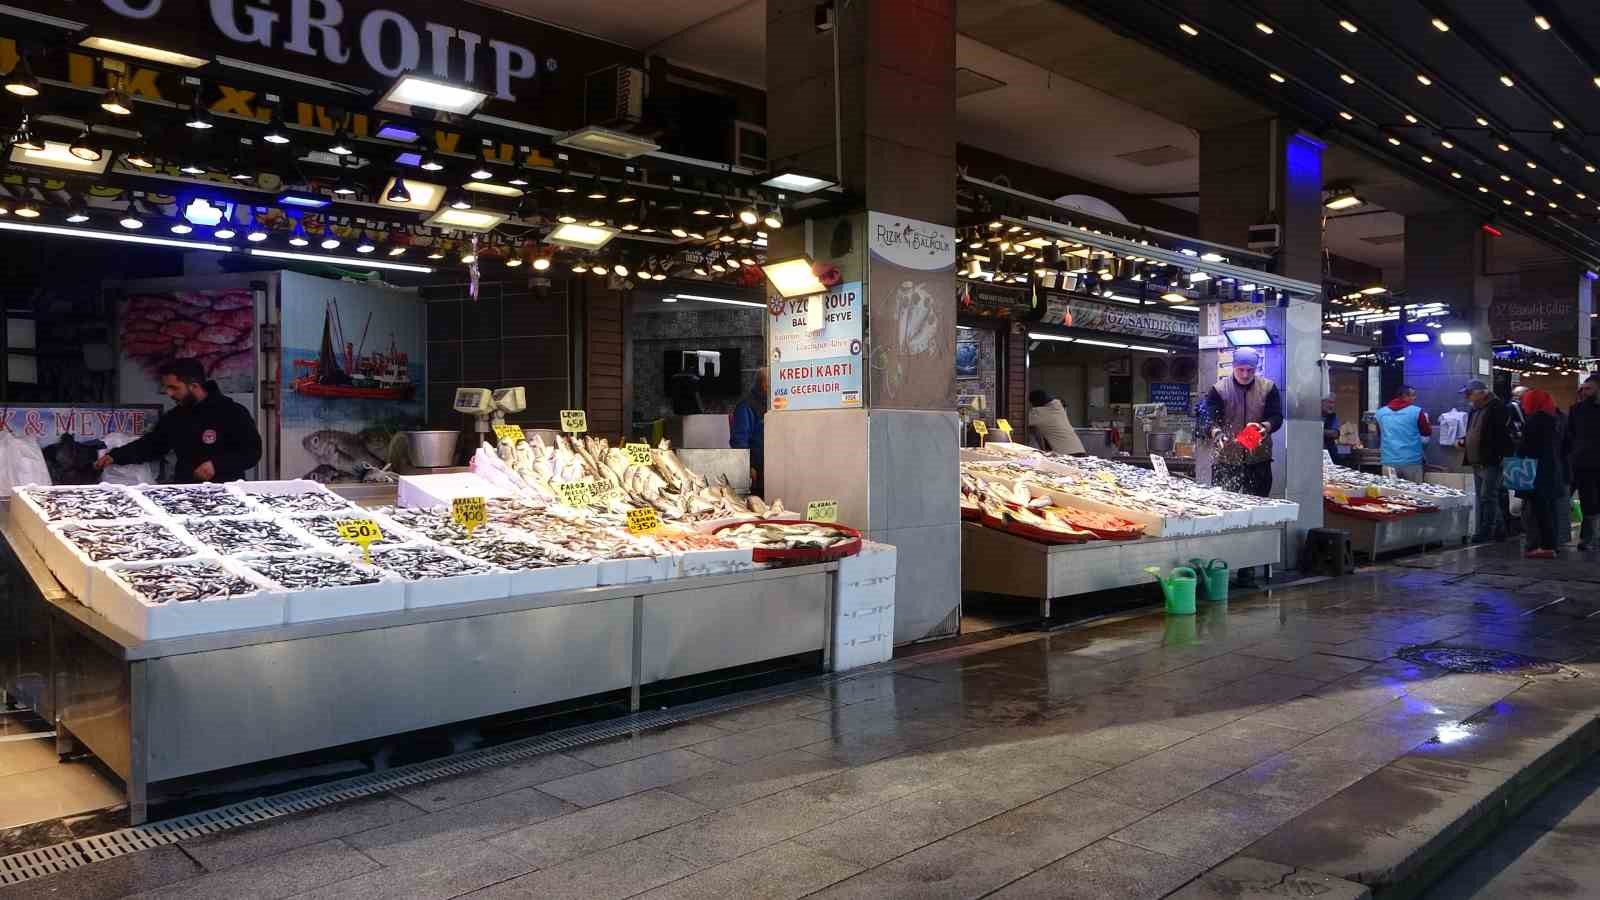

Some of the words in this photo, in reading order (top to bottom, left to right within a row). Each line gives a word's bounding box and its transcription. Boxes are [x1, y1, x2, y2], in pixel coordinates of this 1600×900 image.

[825, 292, 856, 309] ROUP
[792, 318, 807, 327] BAL
[779, 363, 813, 381] KREDİ
[816, 363, 852, 378] KARTI
[24, 409, 47, 436] &
[54, 410, 145, 437] MEYVE
[632, 453, 650, 463] 250
[463, 511, 484, 522] 100
[637, 521, 656, 530] 350
[346, 526, 370, 538] 50
